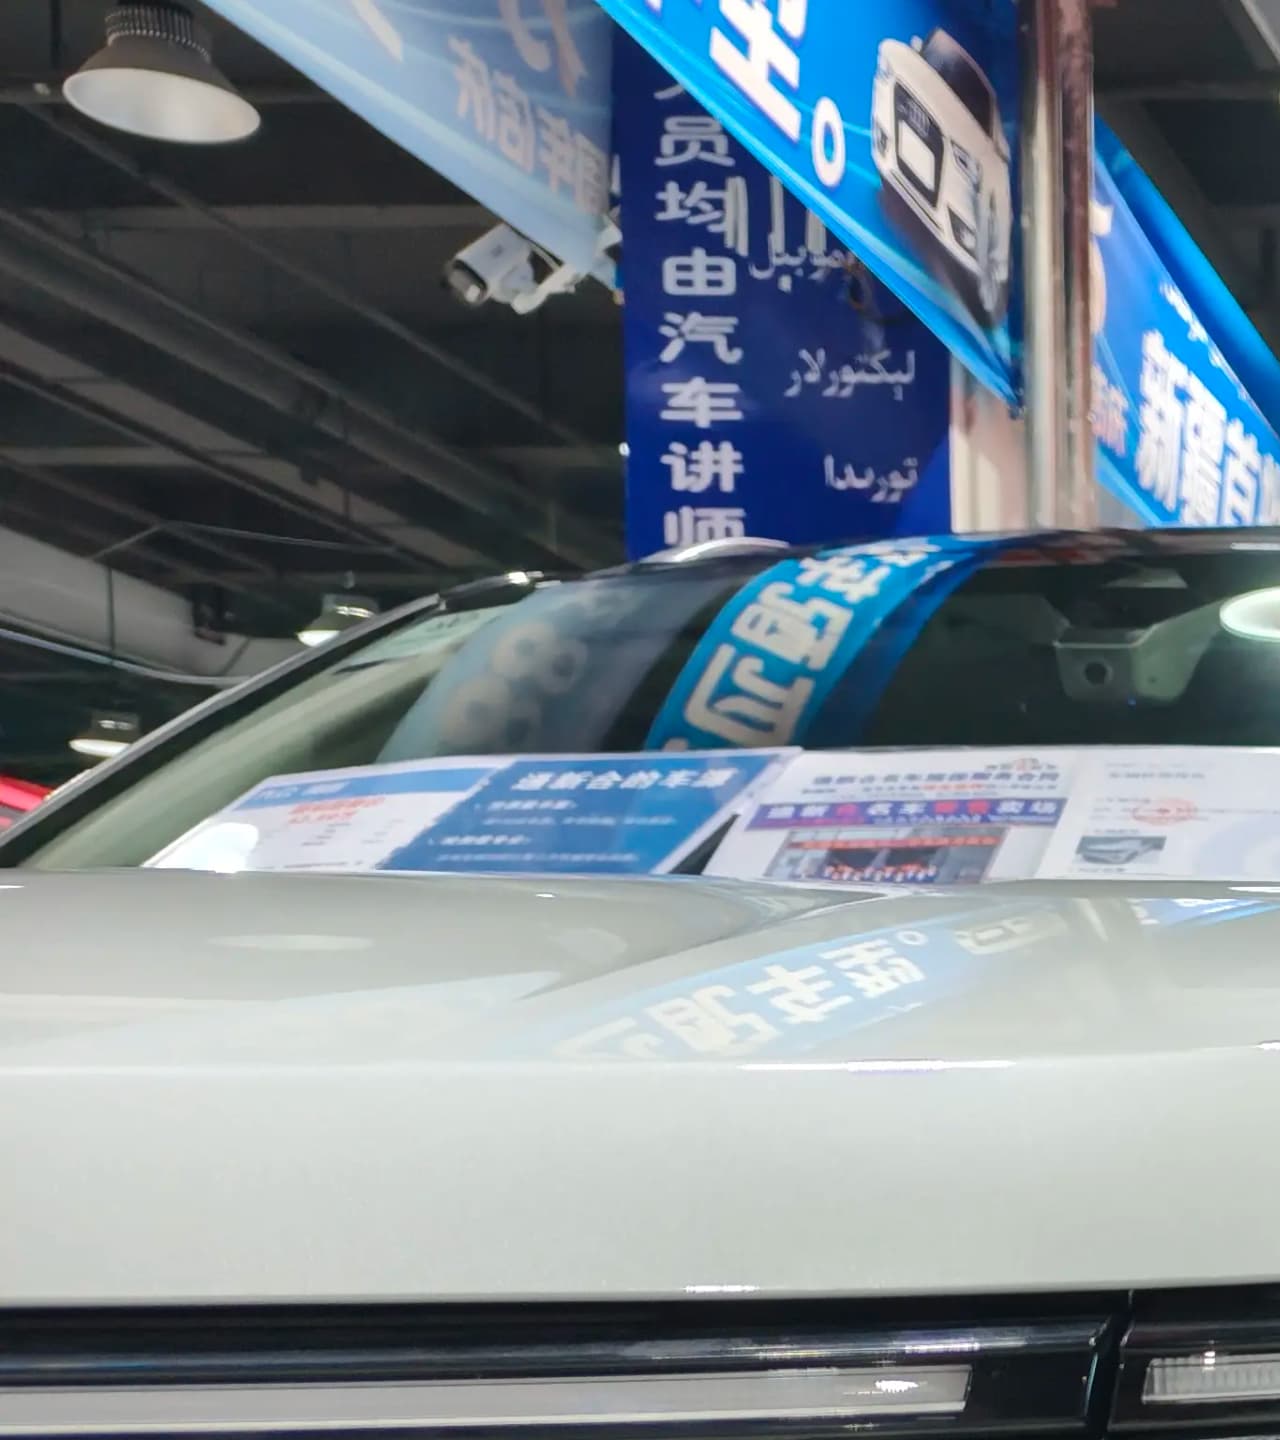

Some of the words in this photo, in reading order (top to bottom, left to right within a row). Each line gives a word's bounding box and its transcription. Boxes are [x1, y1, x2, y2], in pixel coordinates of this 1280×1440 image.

[653, 84, 746, 547] 员均由汽车讲师
